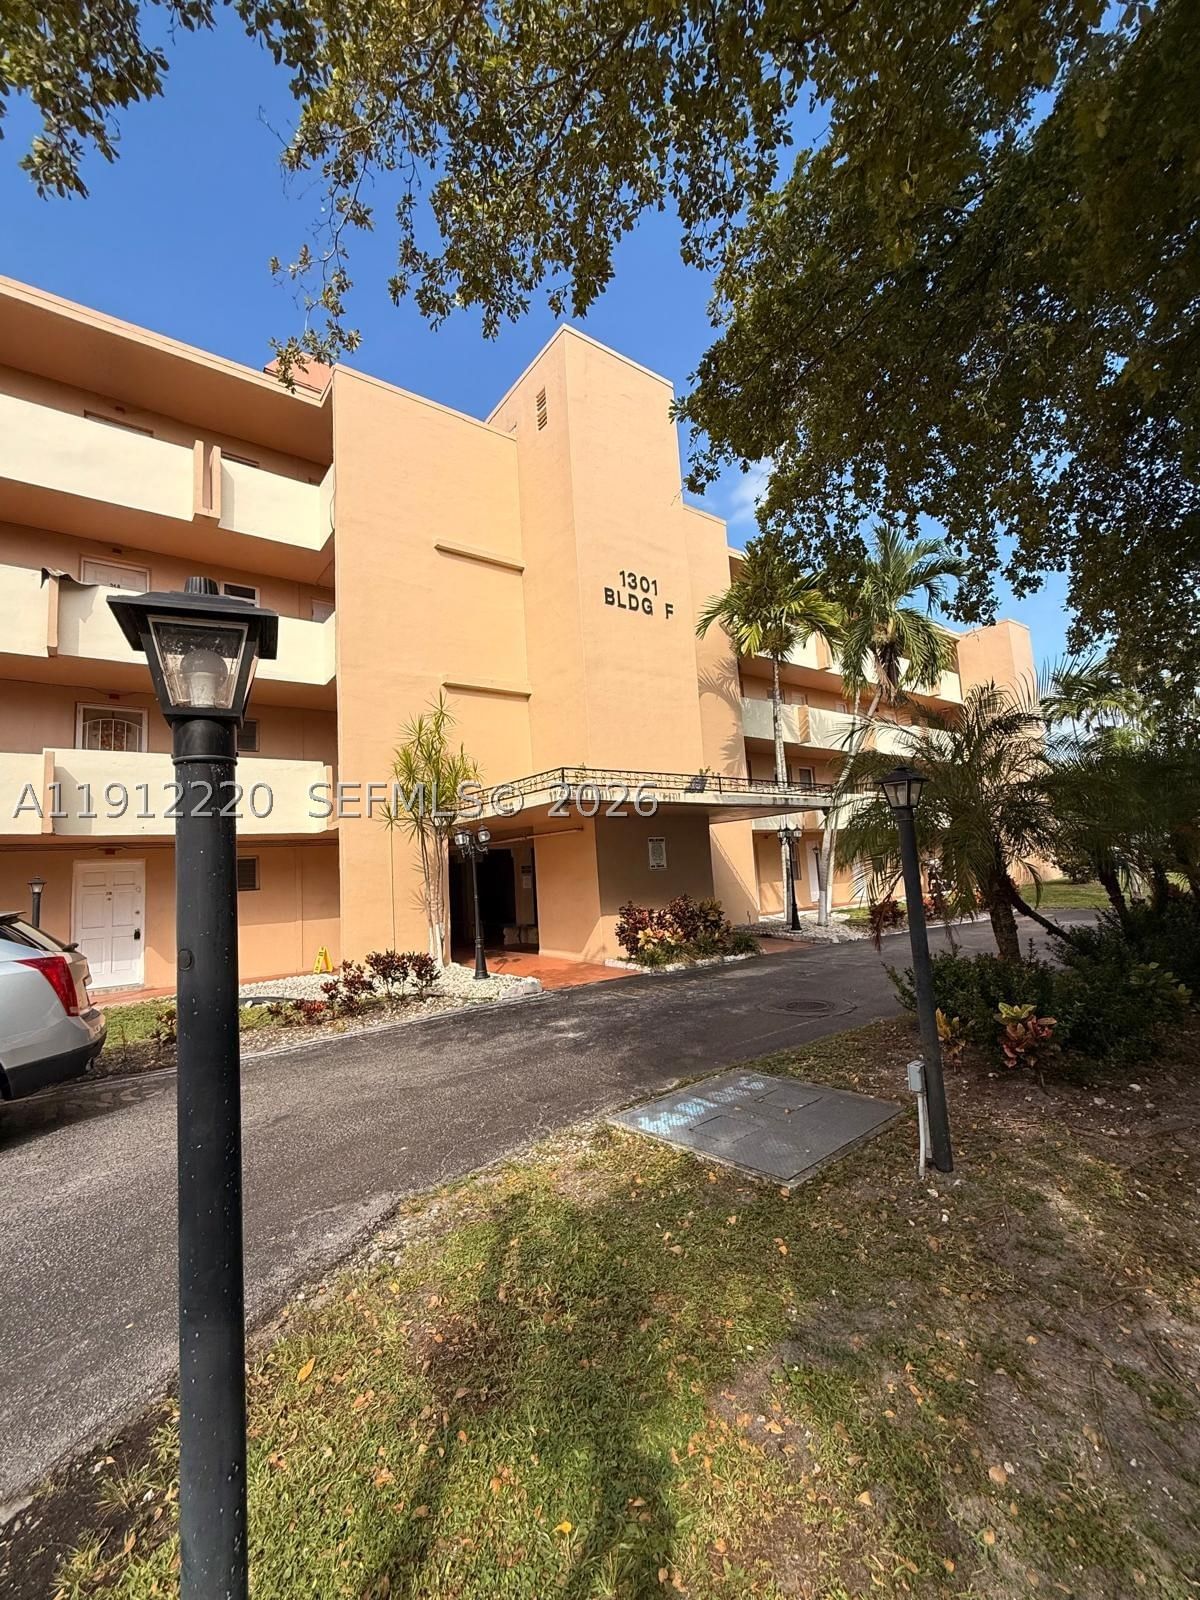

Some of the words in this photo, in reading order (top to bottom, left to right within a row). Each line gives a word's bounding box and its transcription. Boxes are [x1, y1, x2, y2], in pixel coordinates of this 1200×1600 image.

[619, 570, 657, 596] 1301
[604, 587, 653, 616] BLDG
[665, 603, 674, 619] F
